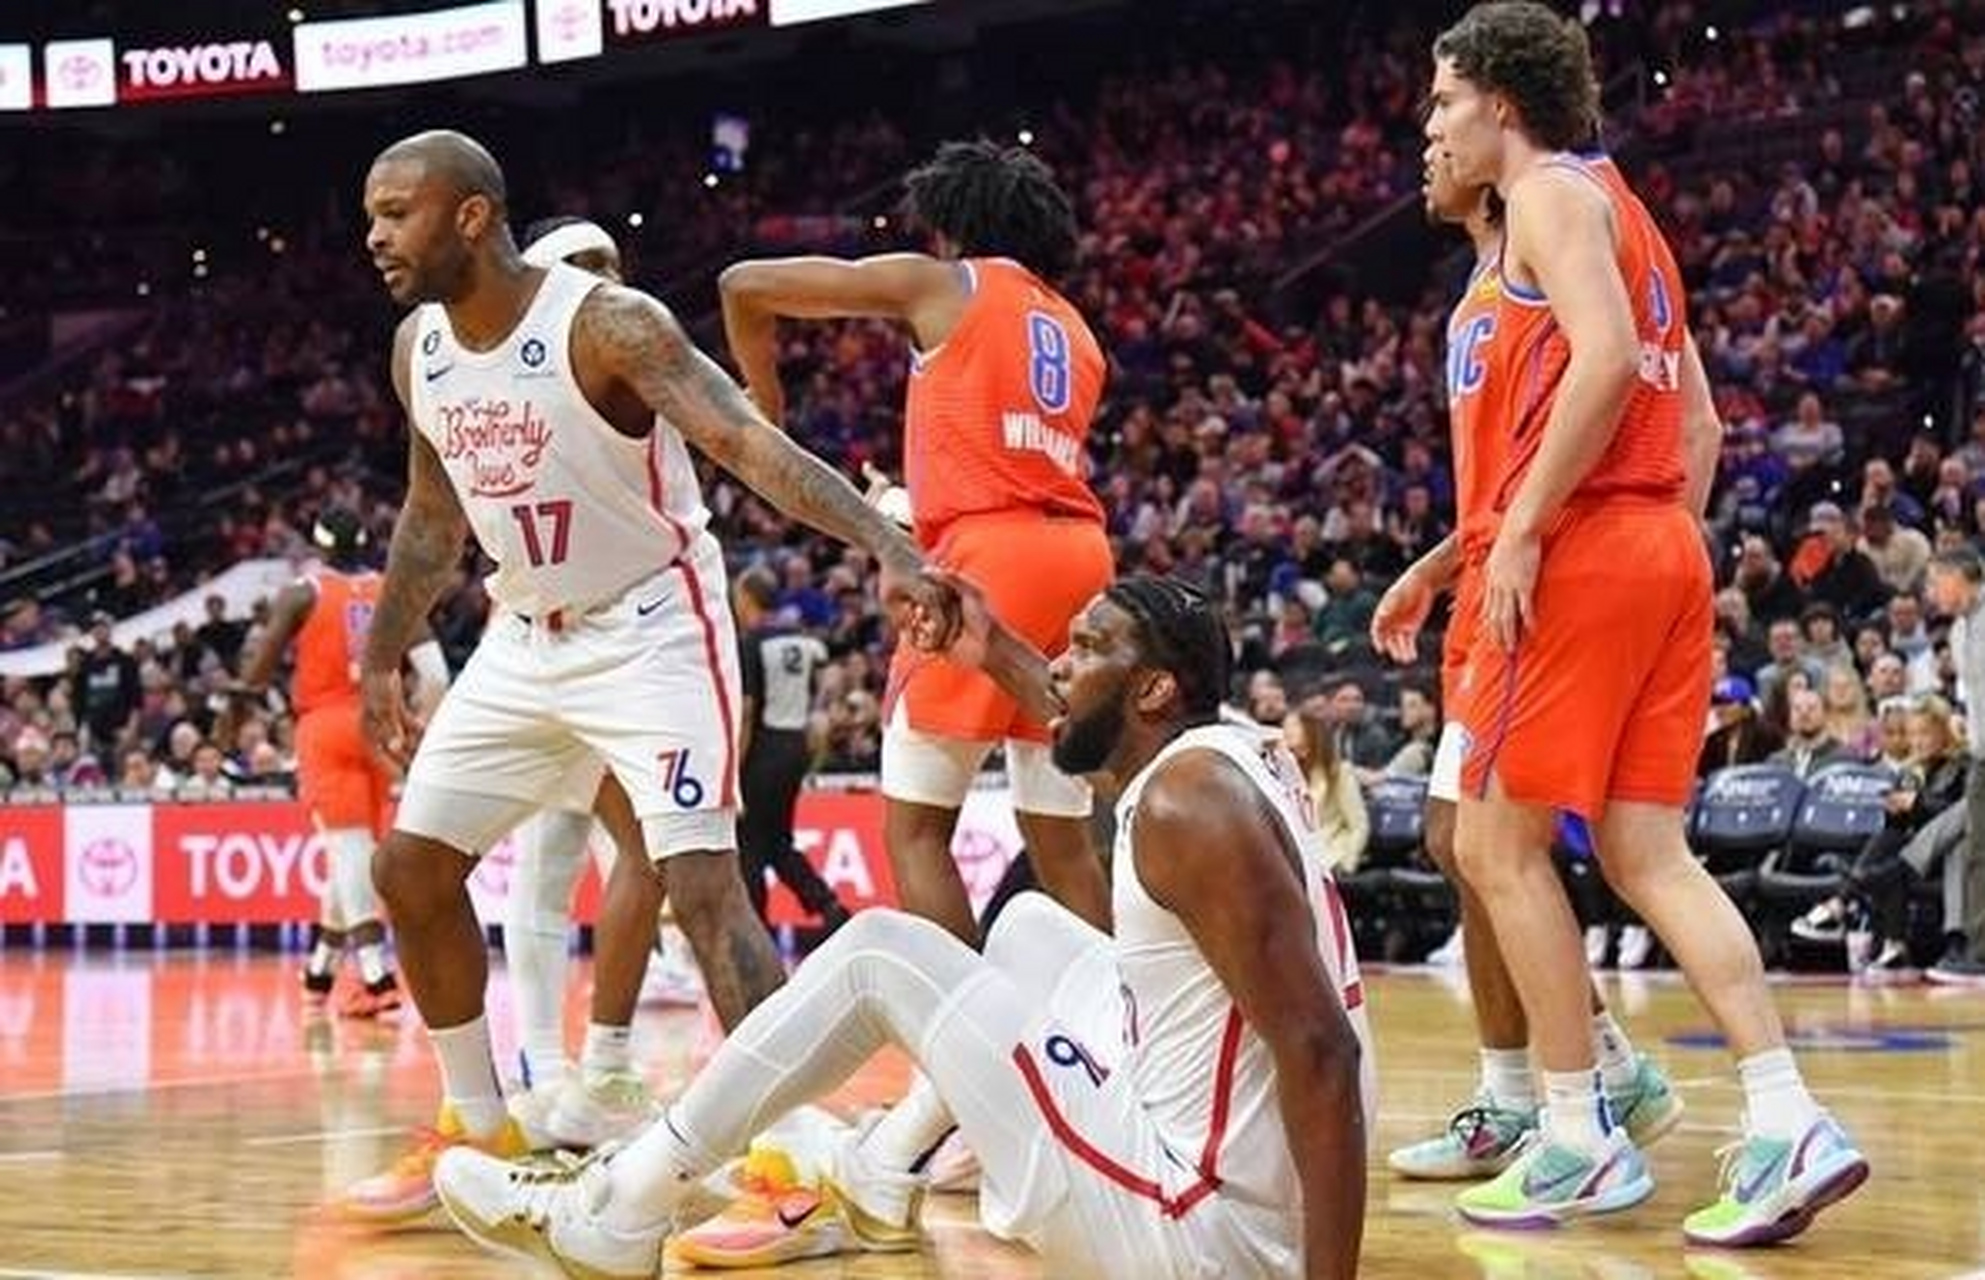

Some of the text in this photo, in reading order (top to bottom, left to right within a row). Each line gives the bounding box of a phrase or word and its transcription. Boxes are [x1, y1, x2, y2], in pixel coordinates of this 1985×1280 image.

[123, 42, 281, 86] TOYOTA
[1027, 309, 1070, 415] 8
[512, 501, 572, 568] 17
[657, 747, 704, 808] 76
